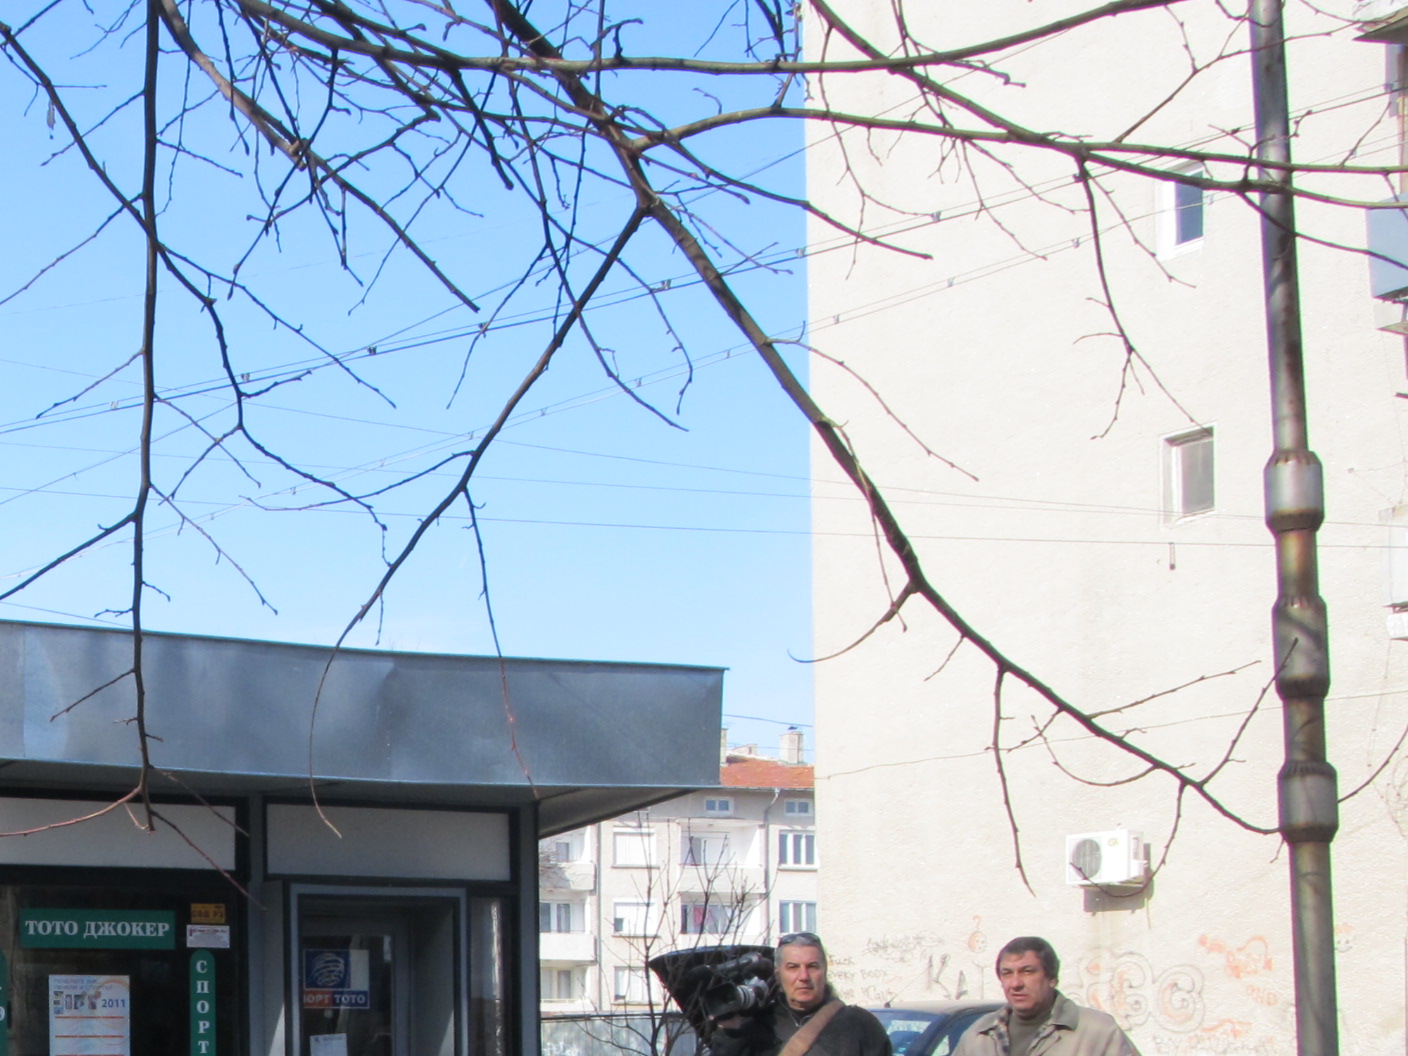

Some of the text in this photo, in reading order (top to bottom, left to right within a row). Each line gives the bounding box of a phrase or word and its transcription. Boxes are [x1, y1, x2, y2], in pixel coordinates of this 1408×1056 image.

[25, 921, 169, 938] ТОТО ДЖОКЕР
[102, 998, 126, 1008] 2011
[335, 995, 366, 1004] ТОТО
[196, 960, 209, 1053] СПОРТ
